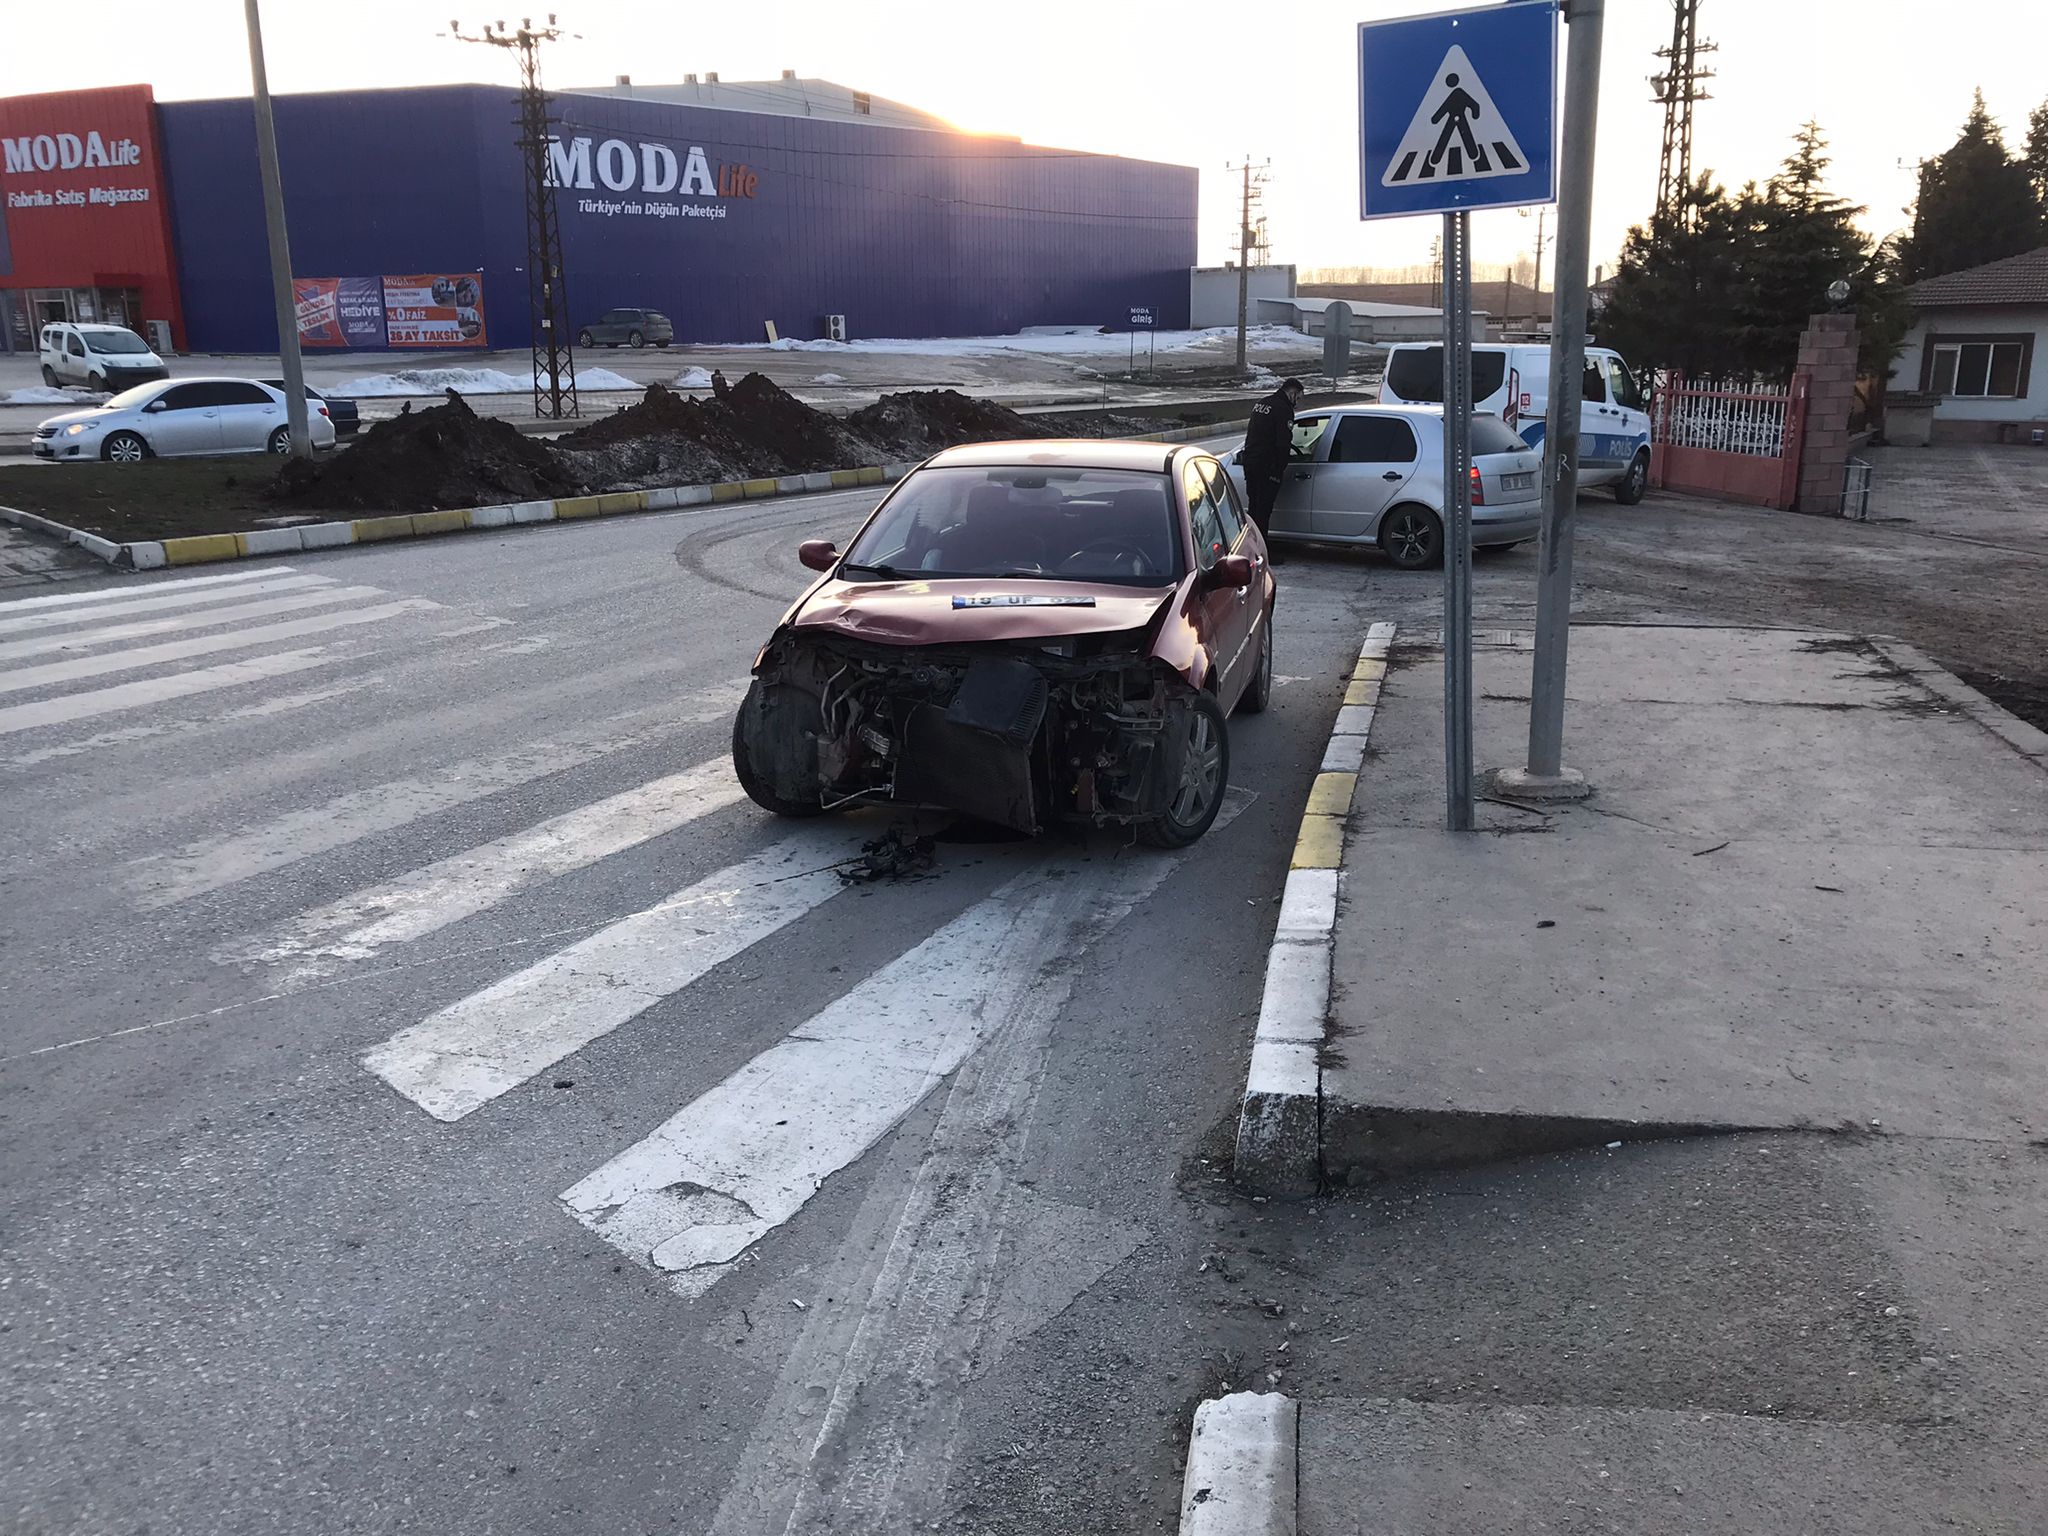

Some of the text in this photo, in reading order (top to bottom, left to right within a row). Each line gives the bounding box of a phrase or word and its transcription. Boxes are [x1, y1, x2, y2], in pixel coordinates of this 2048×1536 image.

[2, 131, 141, 173] MODA Life
[539, 135, 760, 198] MODA Life
[8, 186, 149, 208] Fabrika Satış Mağazası
[578, 199, 726, 221] Türkiye'nin Düğün Paketçisi
[384, 278, 409, 287] MODA
[340, 304, 380, 317] HEDİYE
[406, 308, 426, 320] FAİZ
[1131, 314, 1153, 325] GİRİŞ
[404, 331, 419, 341] AY
[421, 327, 460, 341] TAKSİT
[1609, 437, 1632, 457] POLİS
